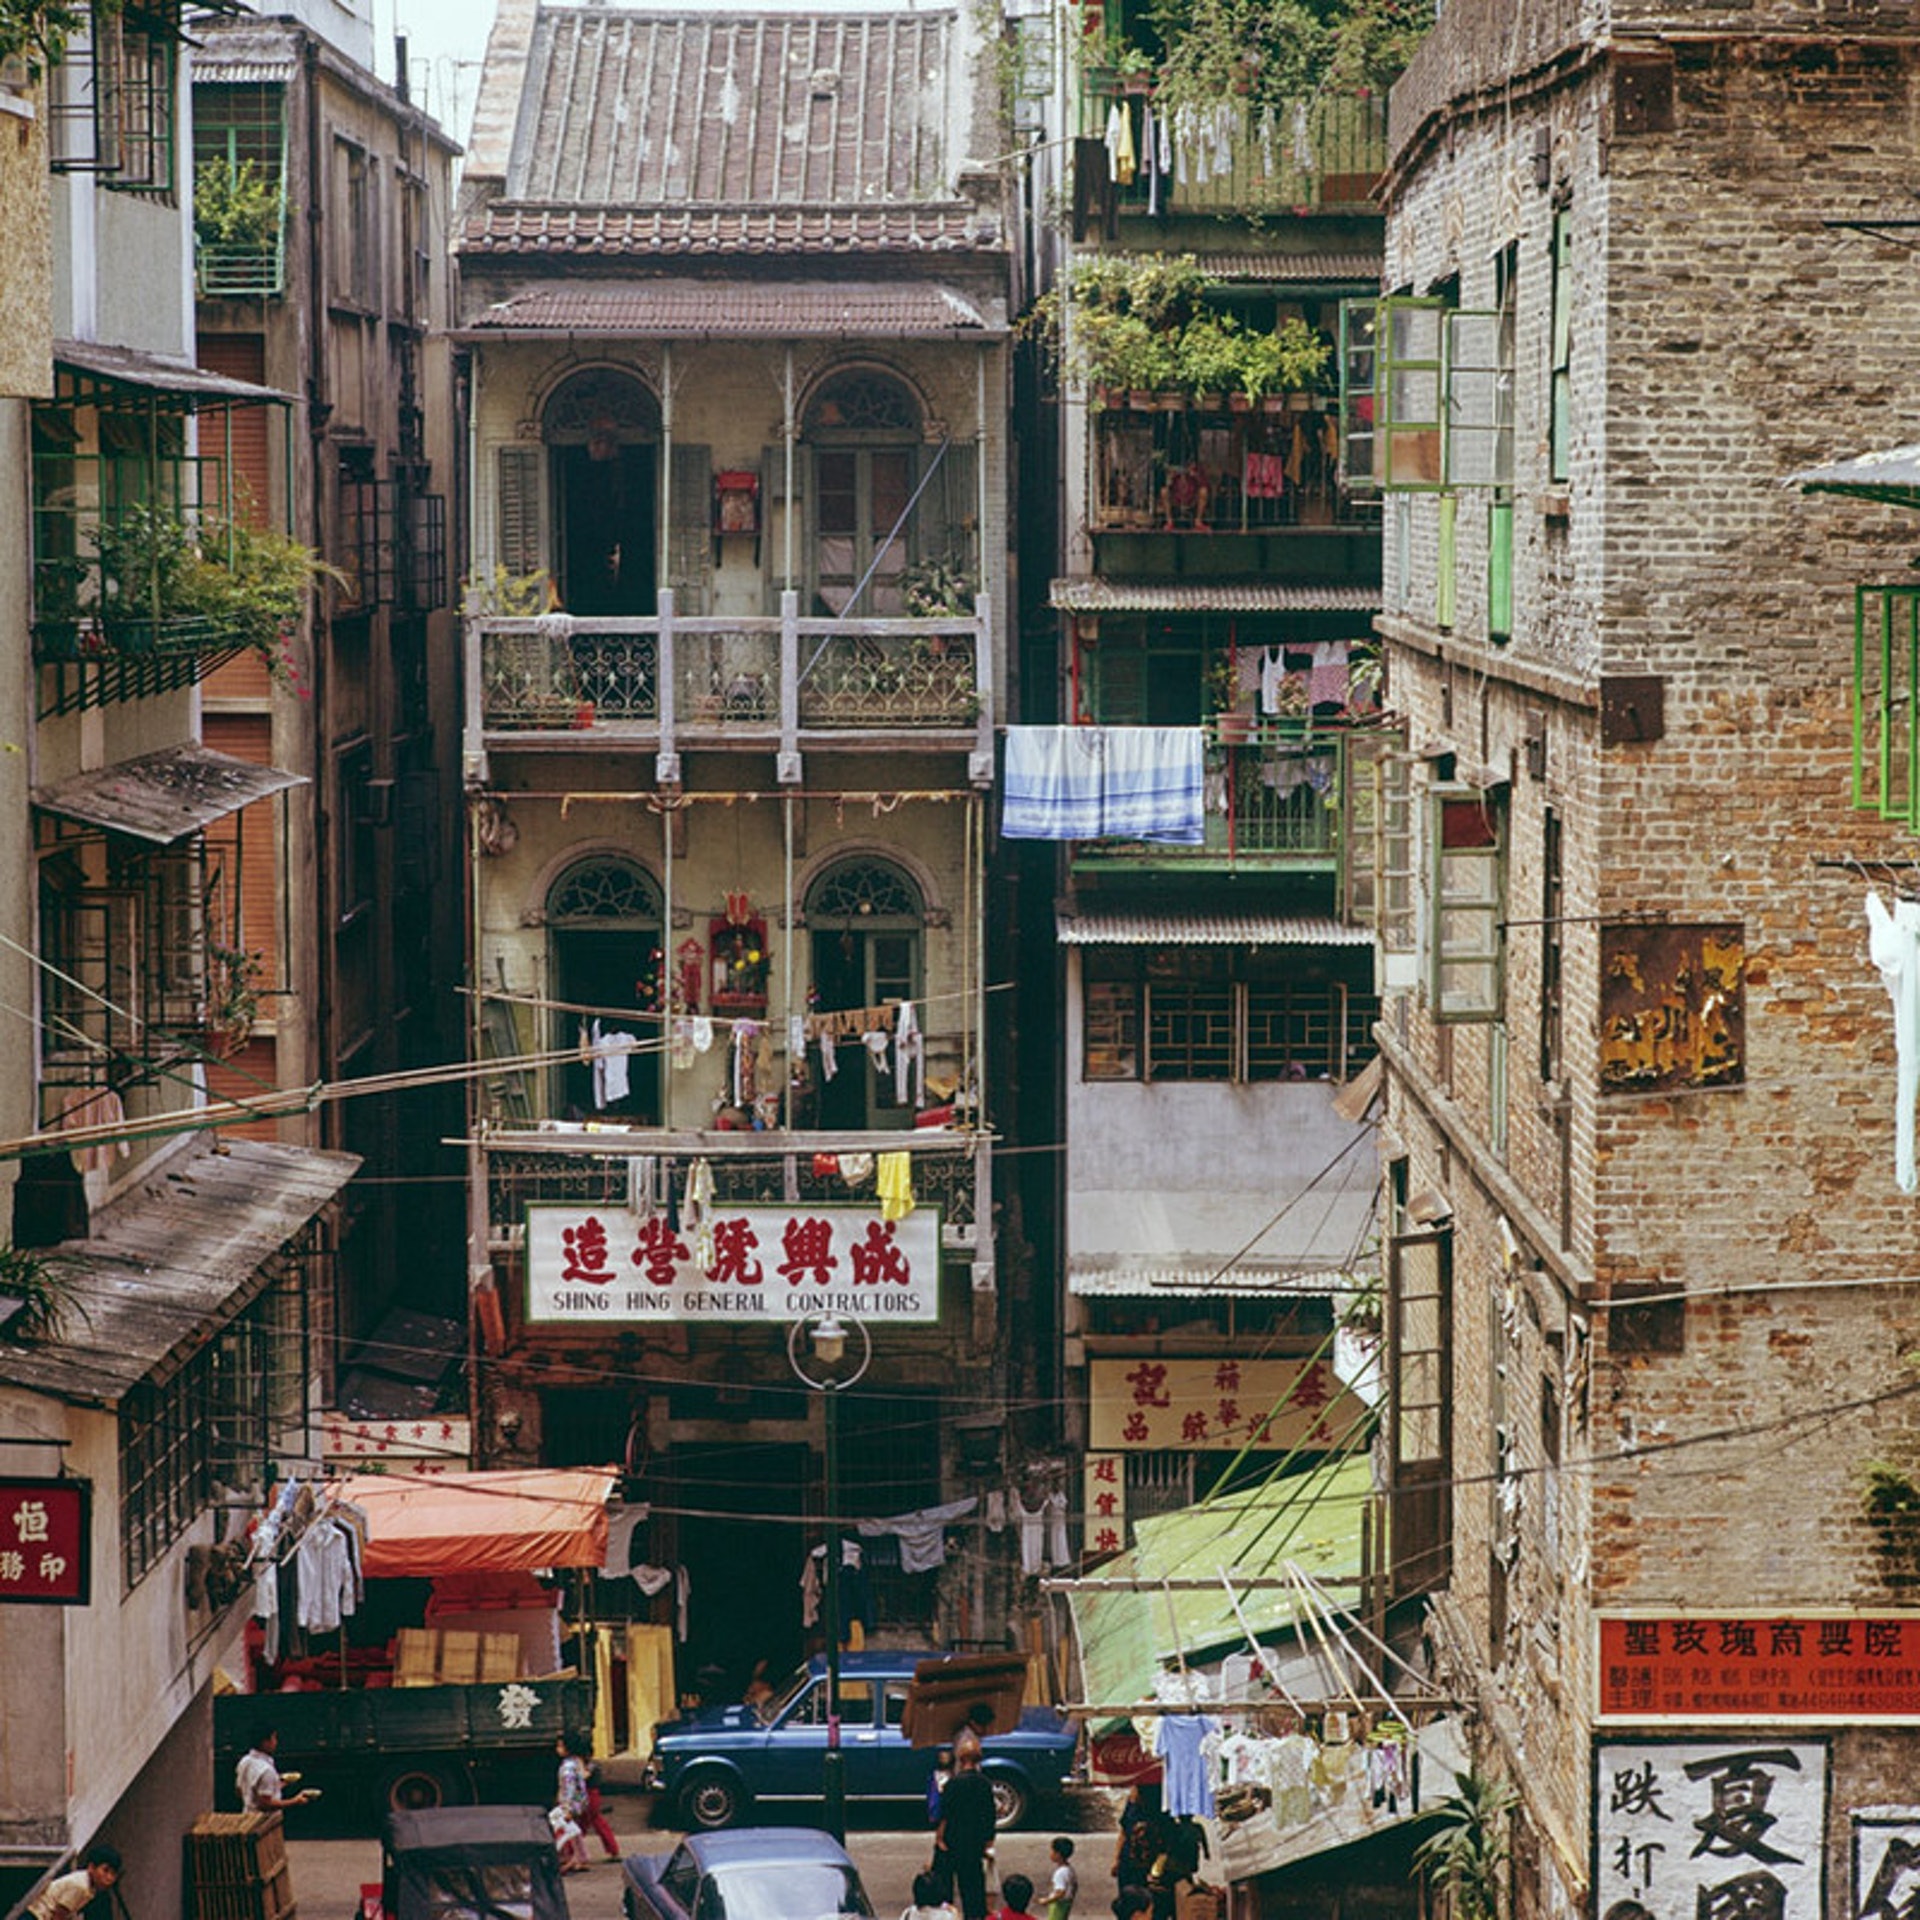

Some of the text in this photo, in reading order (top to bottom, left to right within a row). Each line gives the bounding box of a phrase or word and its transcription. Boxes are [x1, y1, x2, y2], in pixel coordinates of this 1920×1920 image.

[553, 1292, 920, 1312] SHING HING GENERAL CONTRACTORS
[12, 1500, 49, 1543] 恒
[1610, 1760, 1674, 1899] 跌打
